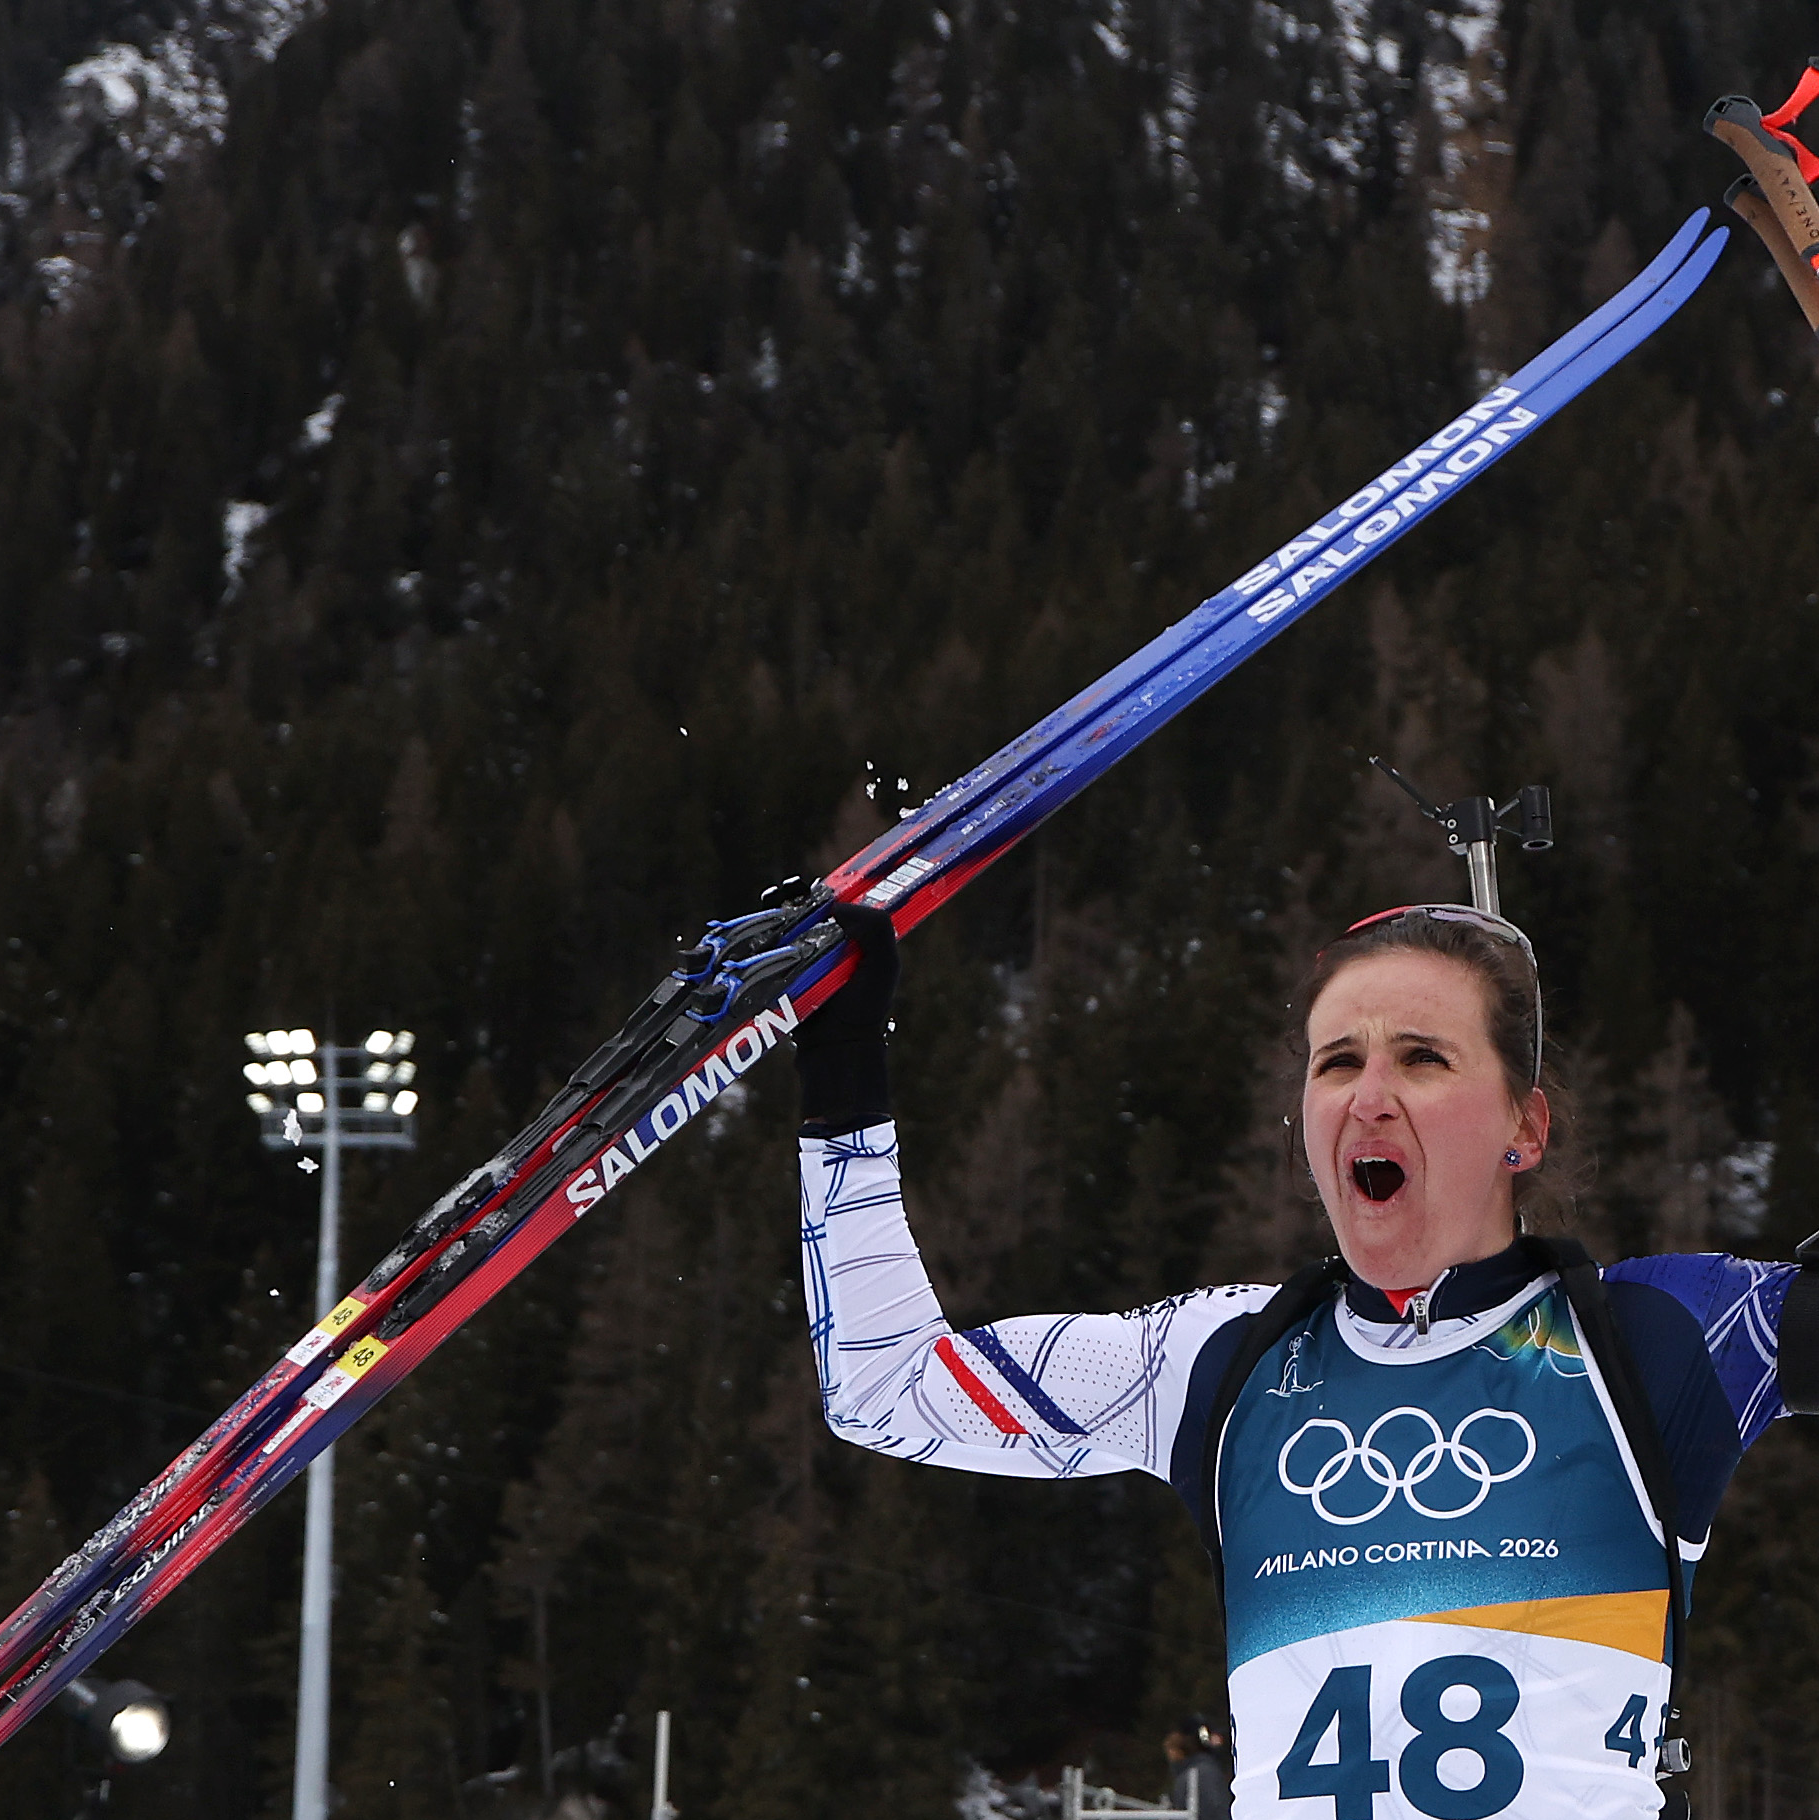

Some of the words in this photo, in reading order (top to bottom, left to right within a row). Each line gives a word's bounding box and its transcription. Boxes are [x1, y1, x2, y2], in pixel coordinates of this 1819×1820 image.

[1232, 385, 1521, 596] SALOMON
[1247, 404, 1538, 624] SALOMON
[565, 993, 800, 1219] SALOMON
[352, 1347, 375, 1368] 48
[1255, 1546, 1359, 1579] MILANO
[1364, 1539, 1492, 1564] CORTINA
[1498, 1538, 1559, 1559] 2026
